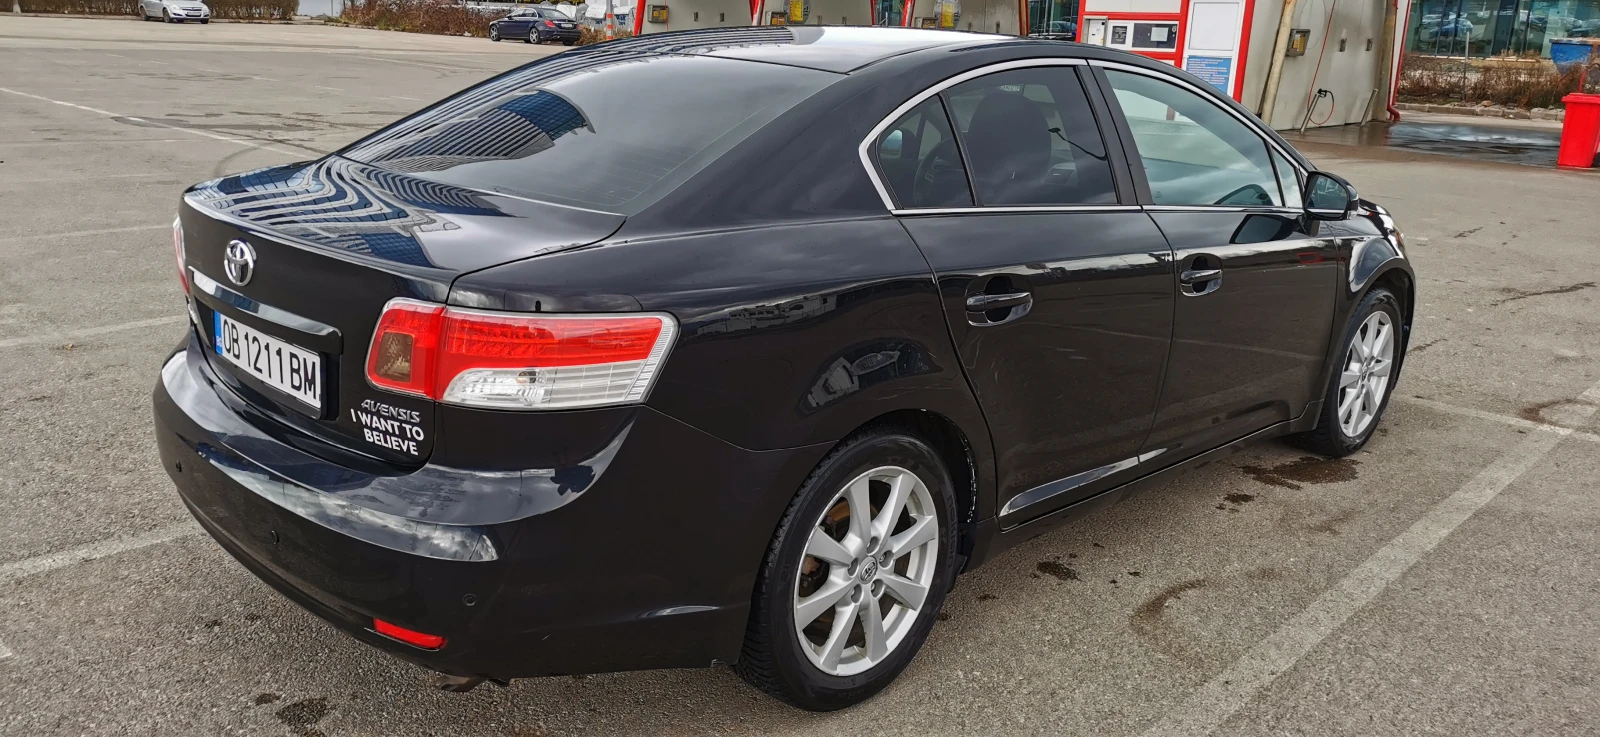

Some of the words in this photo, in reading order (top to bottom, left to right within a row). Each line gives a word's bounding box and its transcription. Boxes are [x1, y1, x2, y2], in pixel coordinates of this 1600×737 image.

[223, 319, 241, 360] OB
[244, 331, 284, 385] 1211
[289, 351, 317, 400] BM
[350, 408, 357, 423] I
[357, 410, 400, 435] WANT
[402, 423, 425, 441] TO
[361, 399, 420, 423] AVENSIS
[363, 428, 419, 456] BELIEVE
